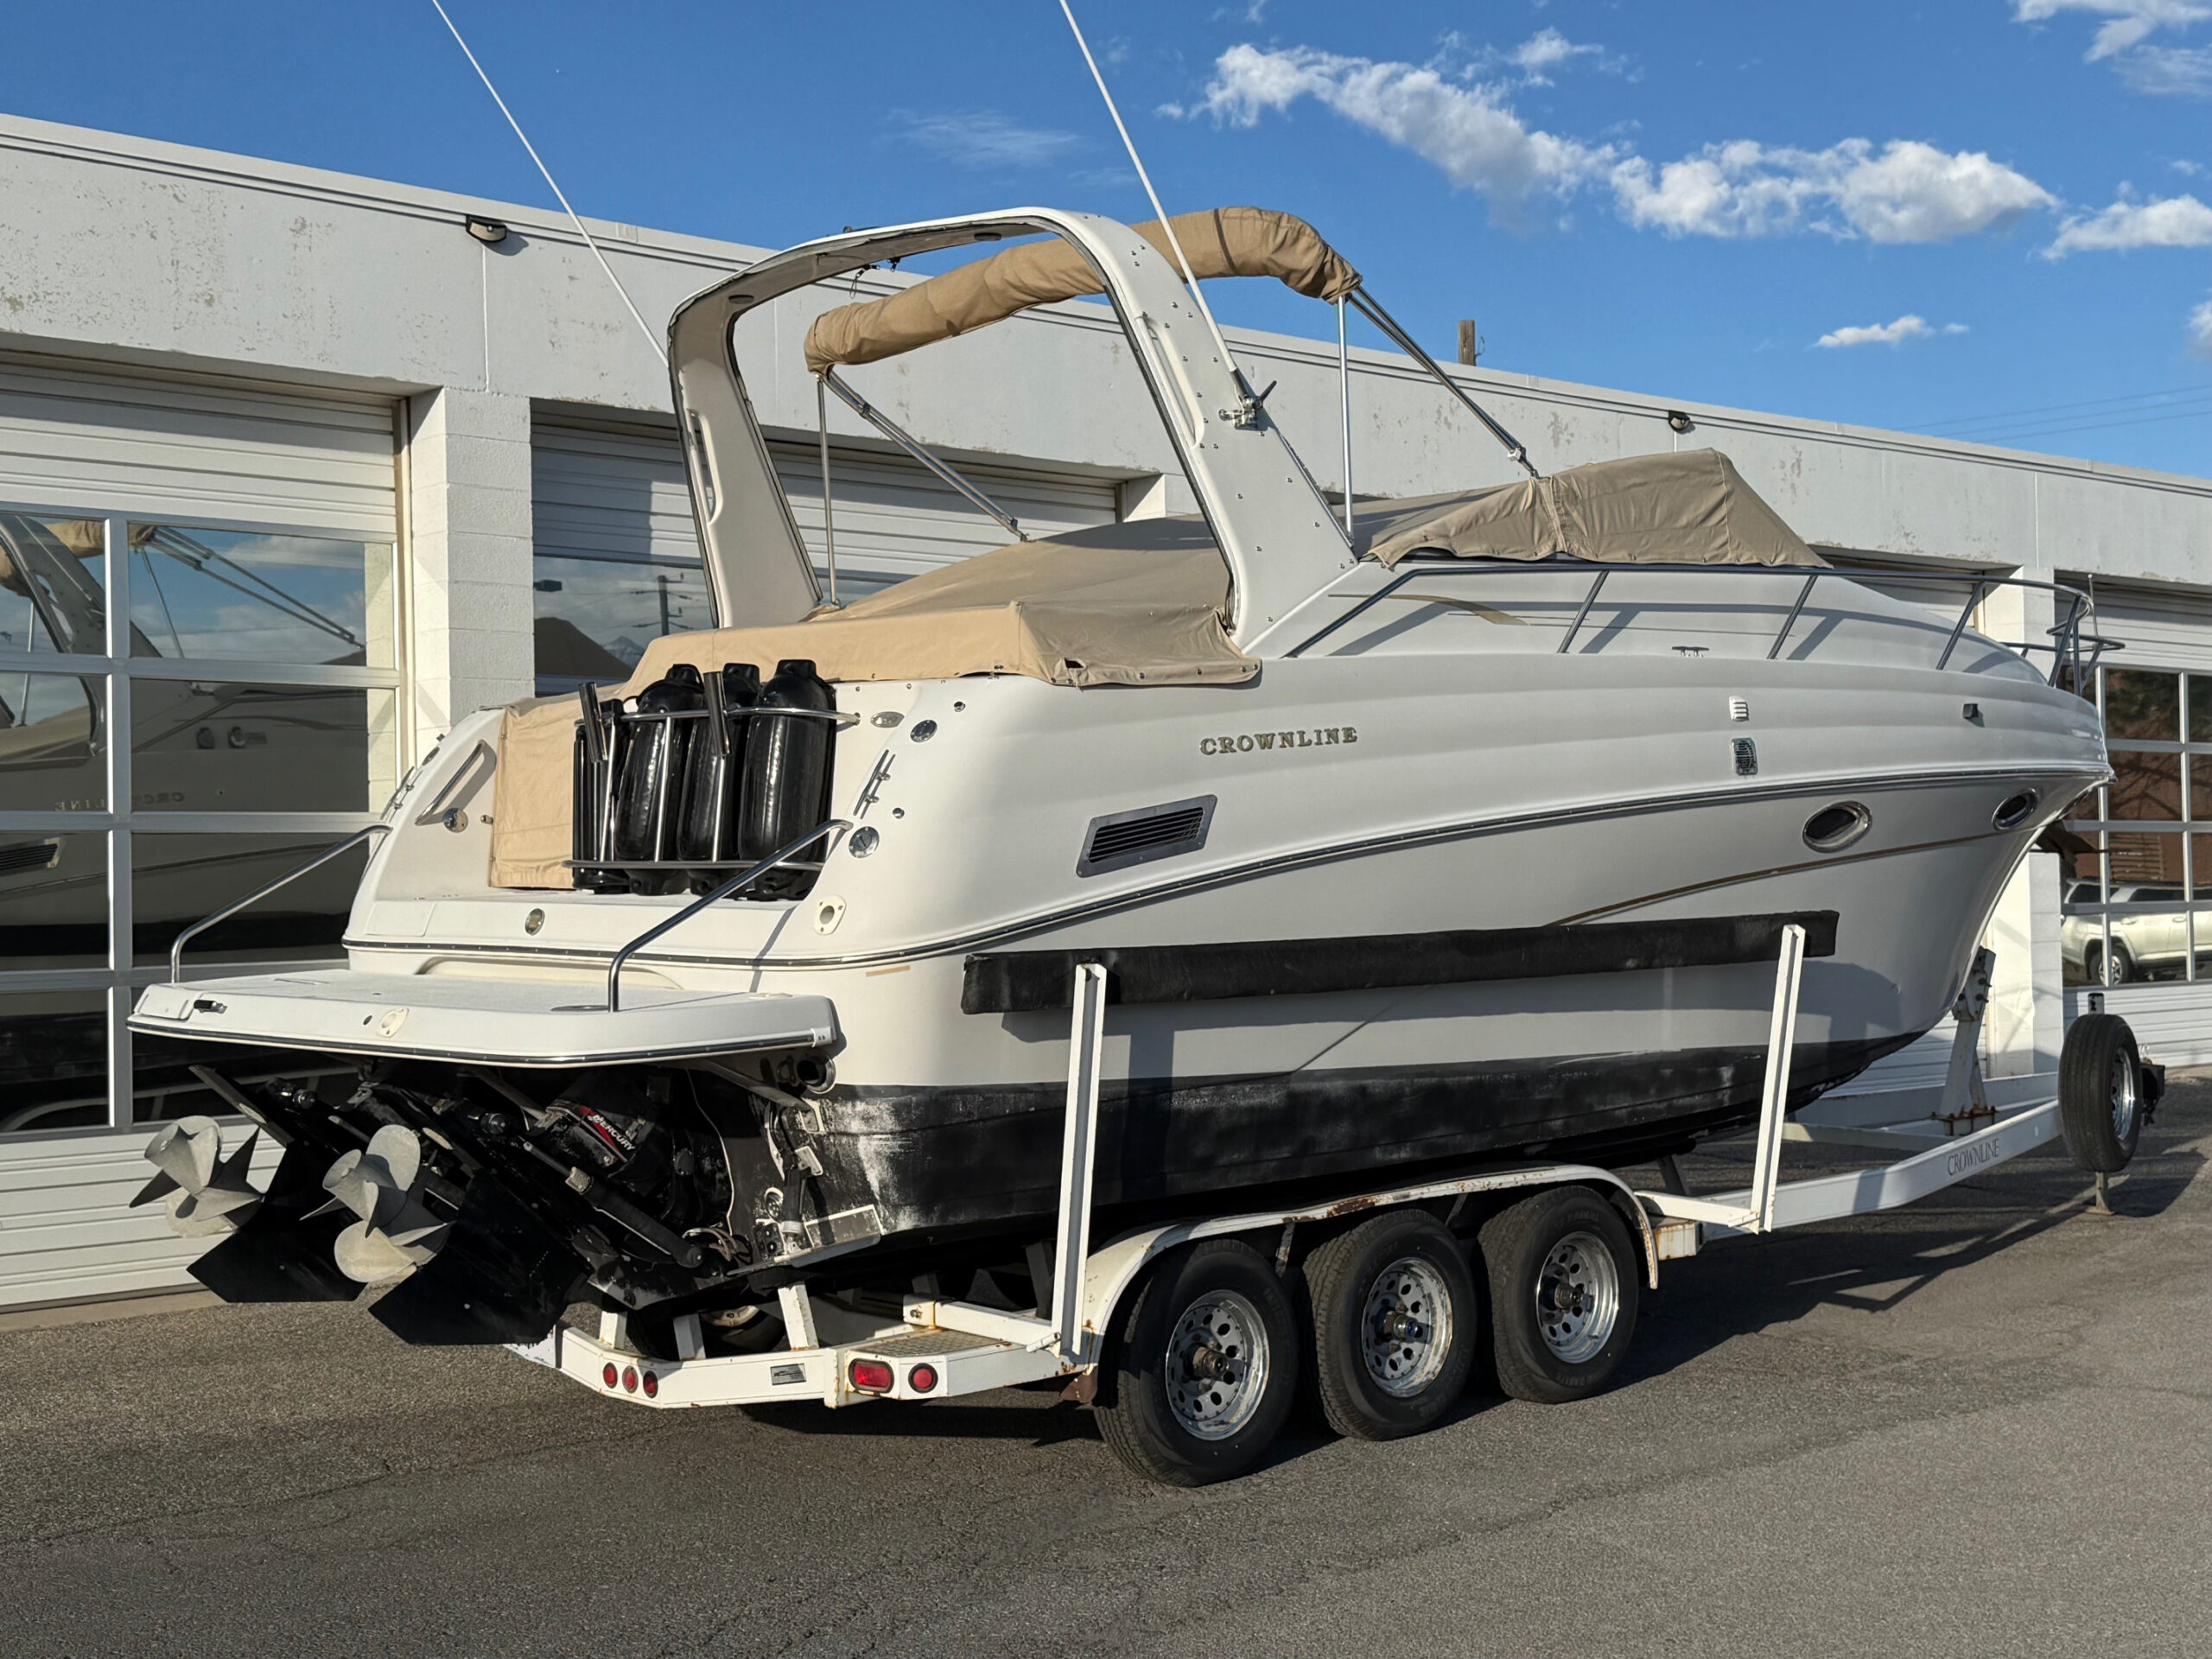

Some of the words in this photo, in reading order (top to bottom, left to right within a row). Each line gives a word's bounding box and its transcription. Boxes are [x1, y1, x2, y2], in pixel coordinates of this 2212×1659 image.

[1199, 727, 1357, 755] CROWNLINE
[588, 1114, 635, 1151] MERCURY
[1948, 1138, 1999, 1176] CROWNLINE
